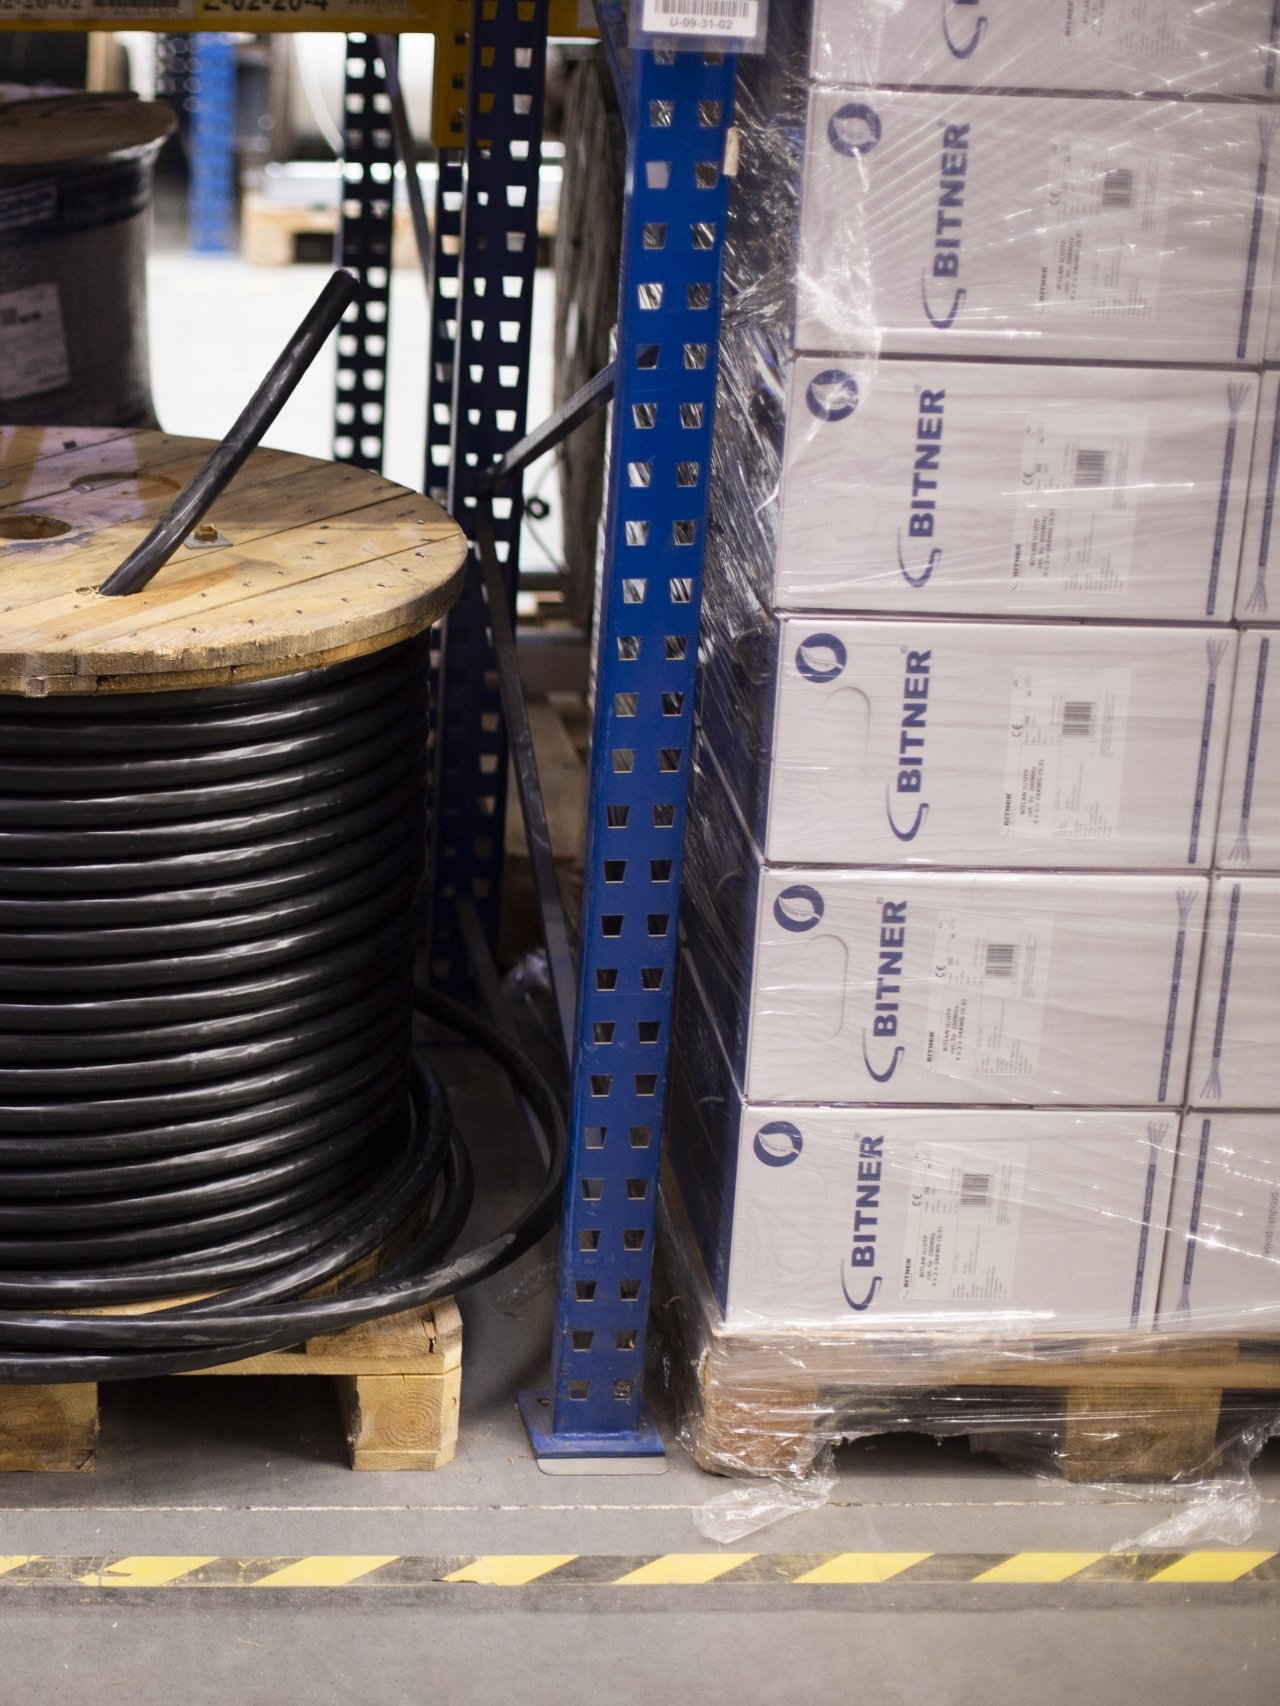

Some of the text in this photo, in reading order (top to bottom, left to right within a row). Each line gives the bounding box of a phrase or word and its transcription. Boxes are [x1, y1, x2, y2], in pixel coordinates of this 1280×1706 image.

[669, 16, 734, 30] U-09-31-02
[932, 123, 970, 278] BITNER
[908, 389, 946, 537] BITNER
[1013, 544, 1022, 577] BITNER
[896, 650, 931, 793] BITNER
[1004, 793, 1012, 826] BITNER
[873, 900, 907, 1037] BITNER
[926, 1032, 935, 1062] BITNER
[851, 1136, 884, 1267] BITNER
